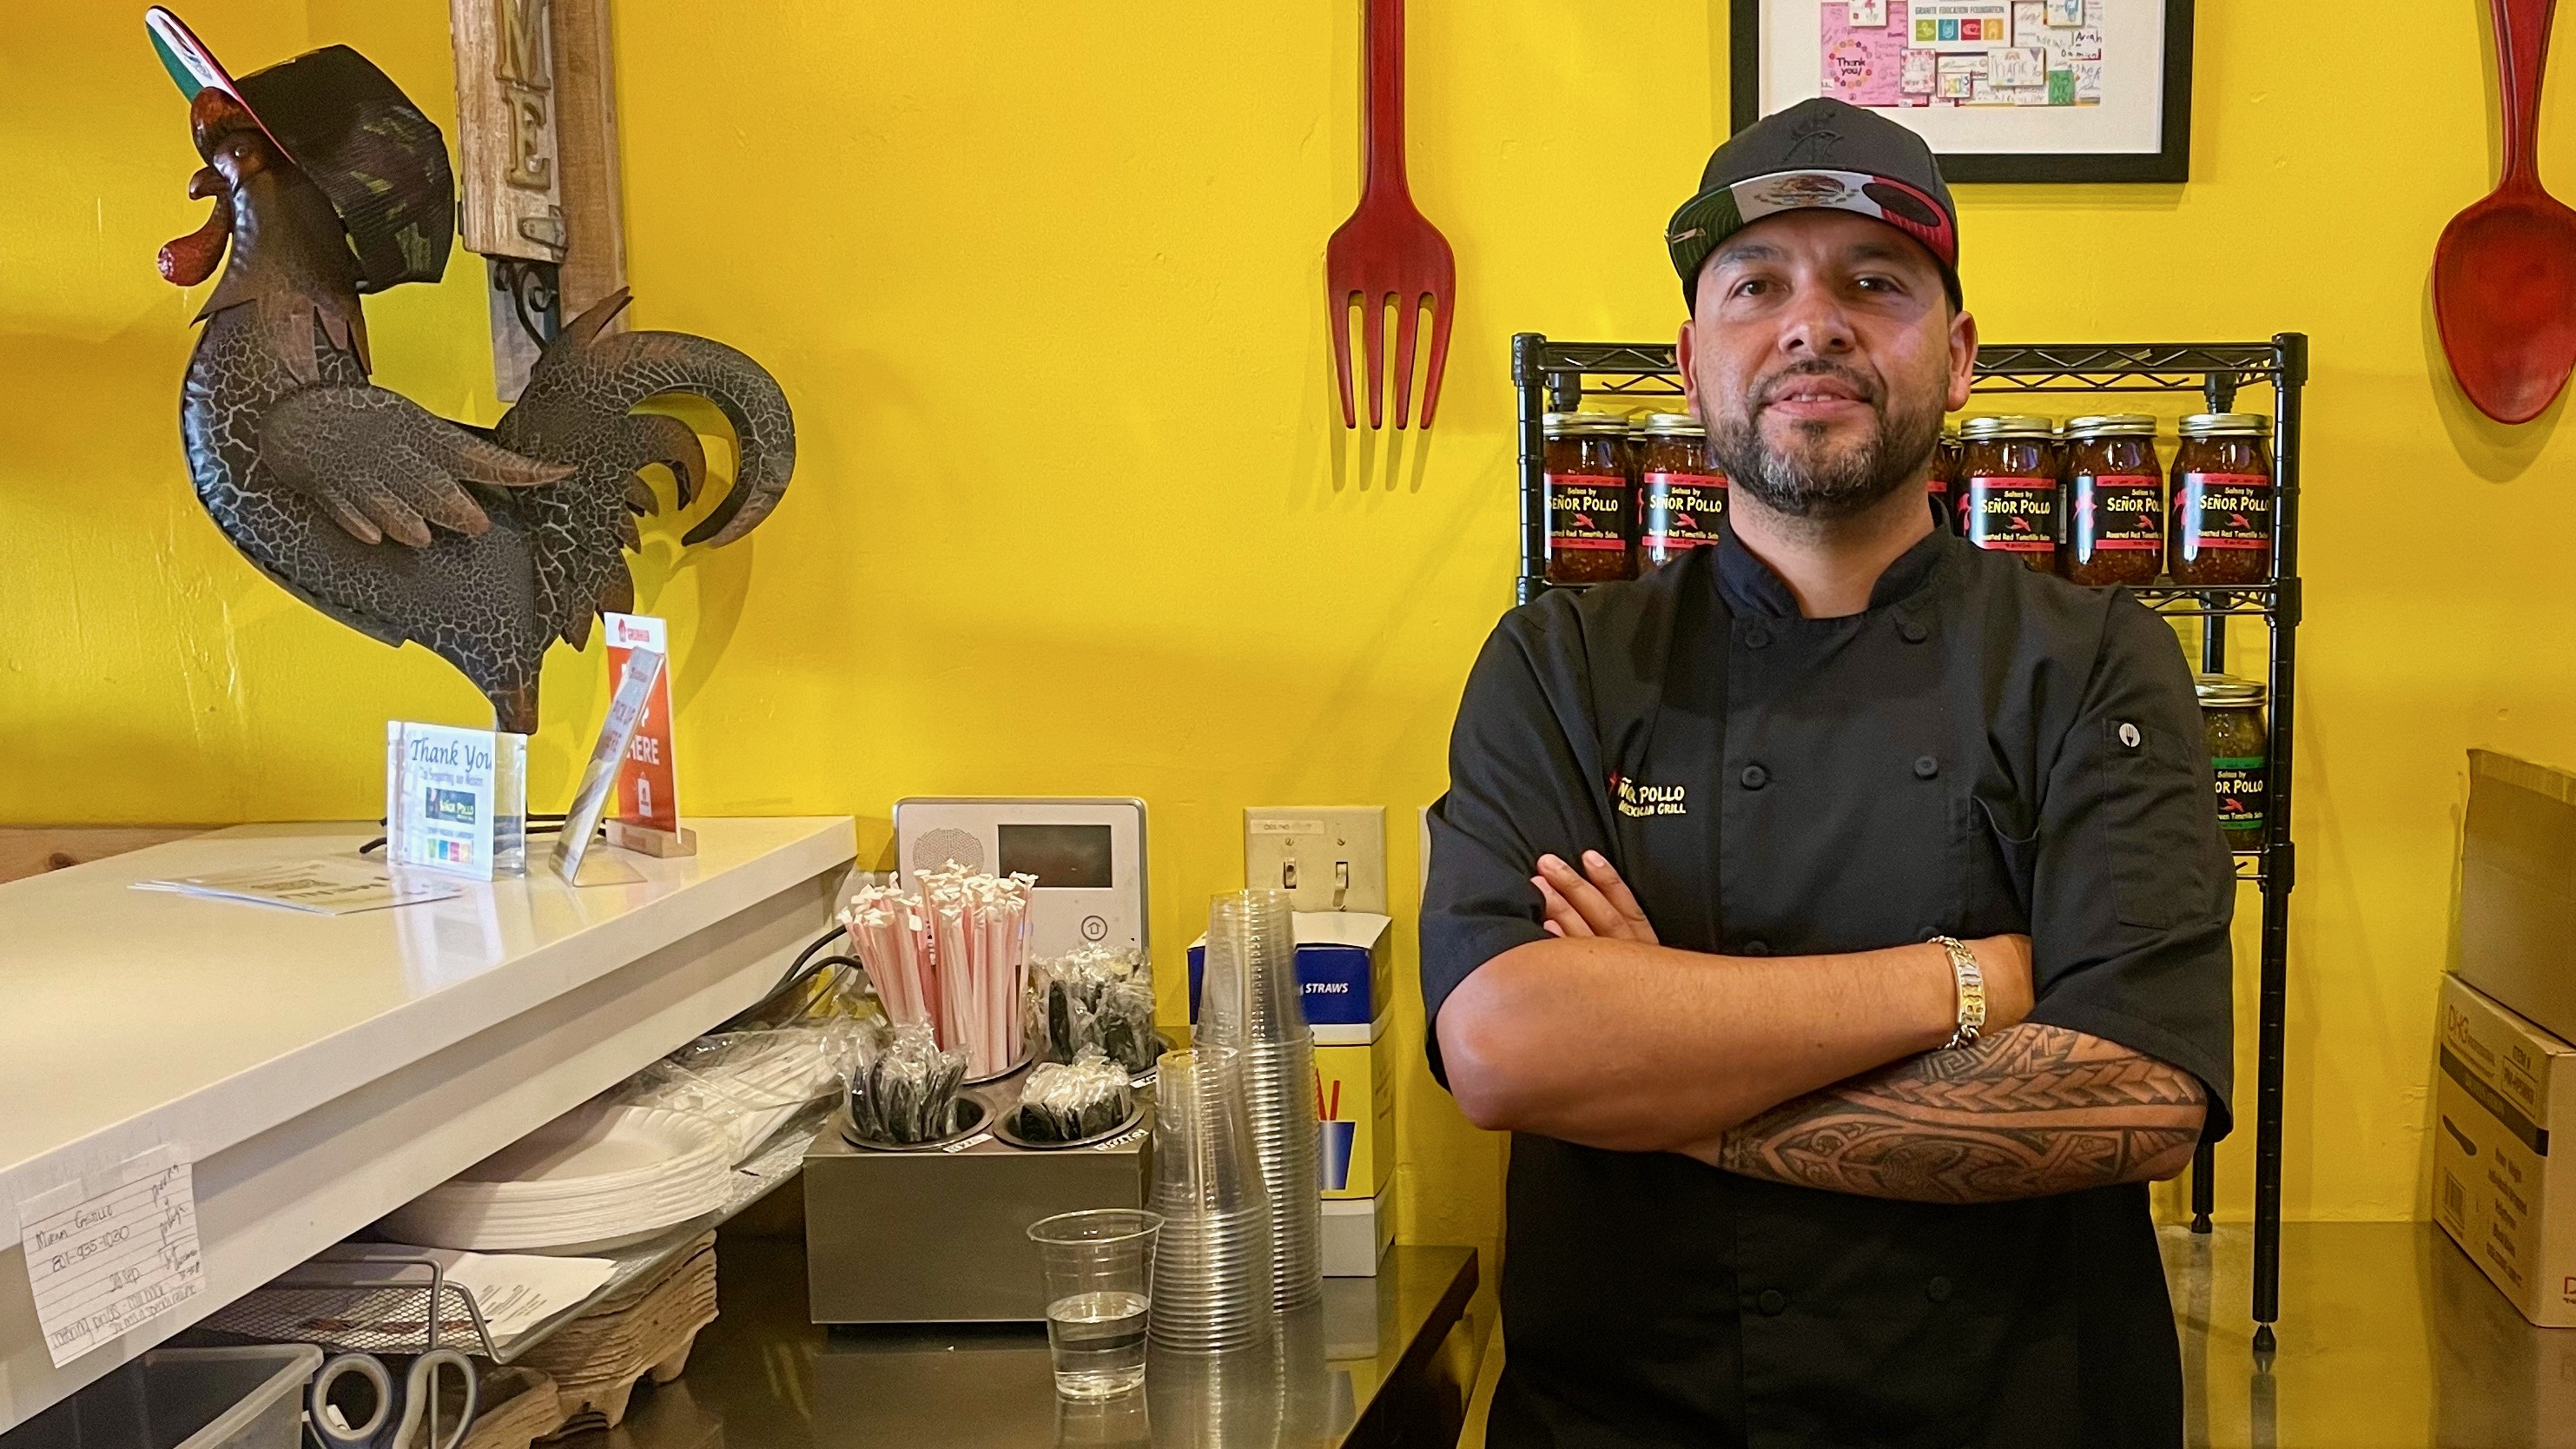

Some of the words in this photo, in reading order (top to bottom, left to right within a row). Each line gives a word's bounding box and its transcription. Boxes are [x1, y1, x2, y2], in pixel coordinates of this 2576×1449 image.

[1836, 57, 1866, 67] Thank
[1589, 487, 1596, 497] by
[1693, 487, 1701, 497] by
[2025, 491, 2032, 500] by
[2246, 487, 2254, 497] by
[1582, 496, 1618, 512] POLLO
[1687, 496, 1722, 513] POLLO
[2020, 500, 2051, 514] POLLO
[2107, 495, 2144, 512] SEÑOR
[2199, 494, 2237, 511] SEÑOR
[411, 737, 459, 766] Thank
[465, 744, 492, 772] You
[2238, 771, 2247, 779] by
[2233, 779, 2263, 794] POLLO
[1639, 785, 1685, 804] POLLO
[1657, 803, 1687, 815] GRILL
[1305, 983, 1349, 994] STRAWS
